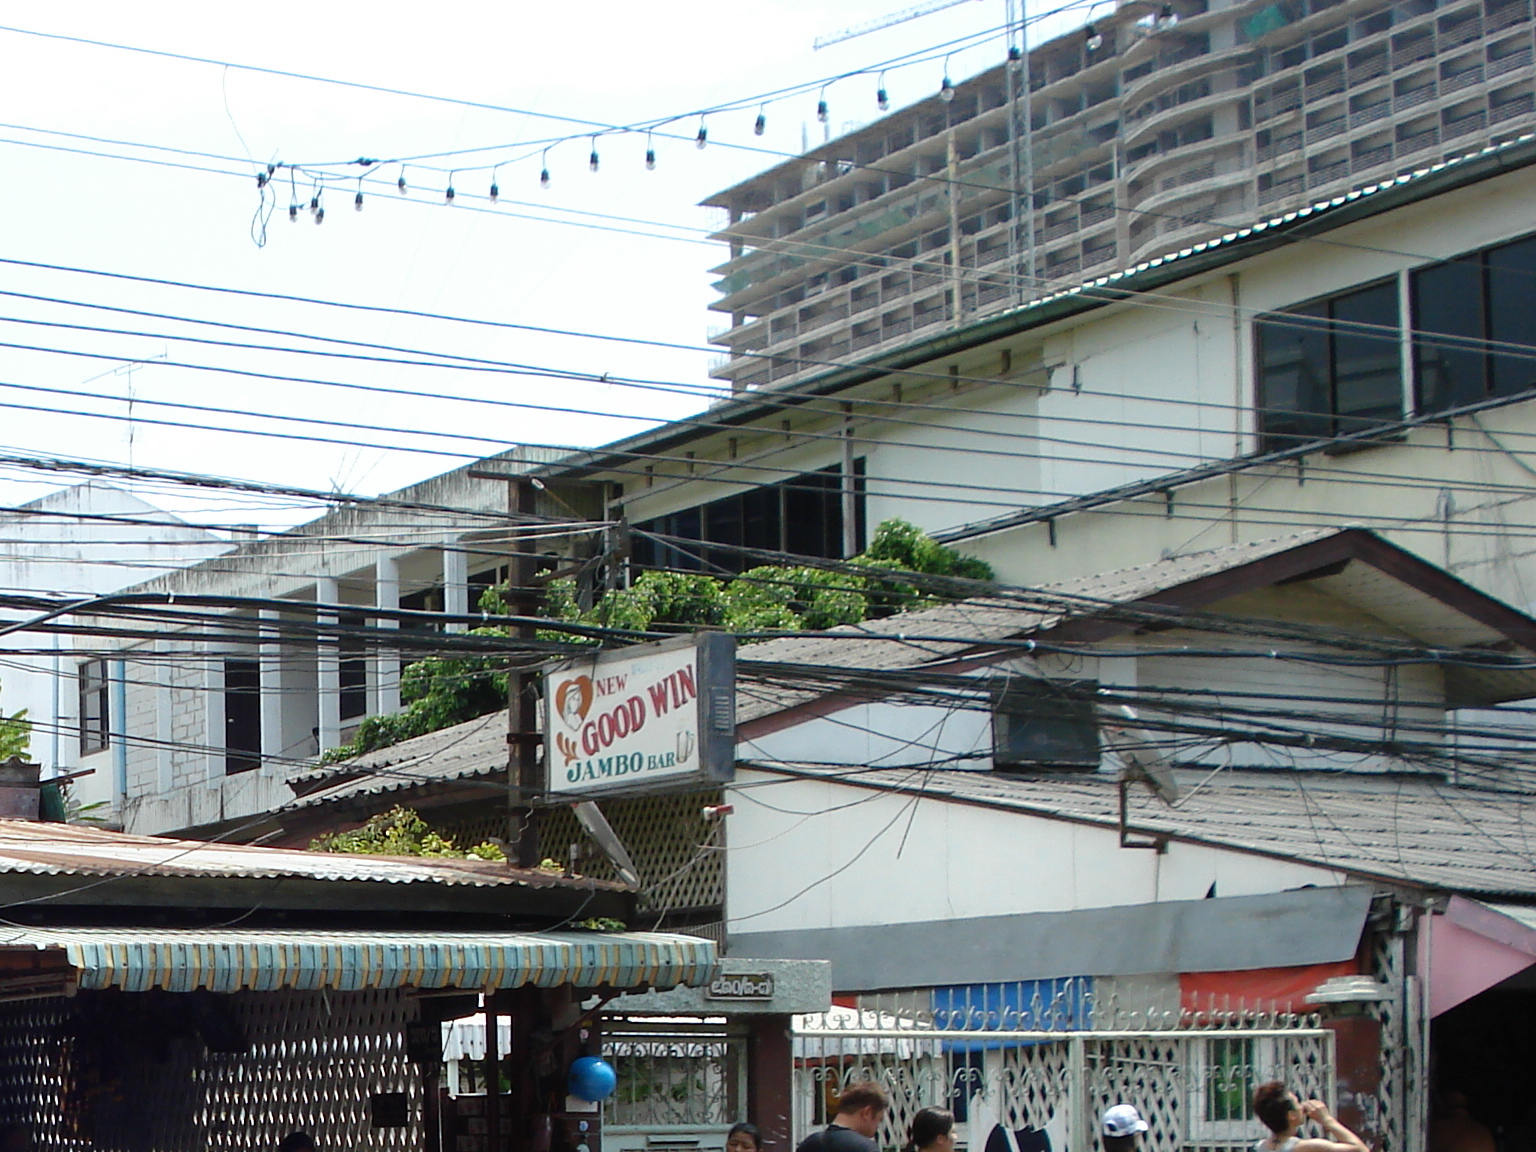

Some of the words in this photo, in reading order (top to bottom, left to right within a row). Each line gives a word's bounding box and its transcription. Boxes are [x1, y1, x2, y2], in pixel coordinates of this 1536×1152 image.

[596, 674, 628, 697] NEW
[582, 696, 646, 756] GOOD
[647, 664, 696, 718] WIN
[567, 752, 644, 783] JAMBO
[647, 752, 677, 770] BAR
